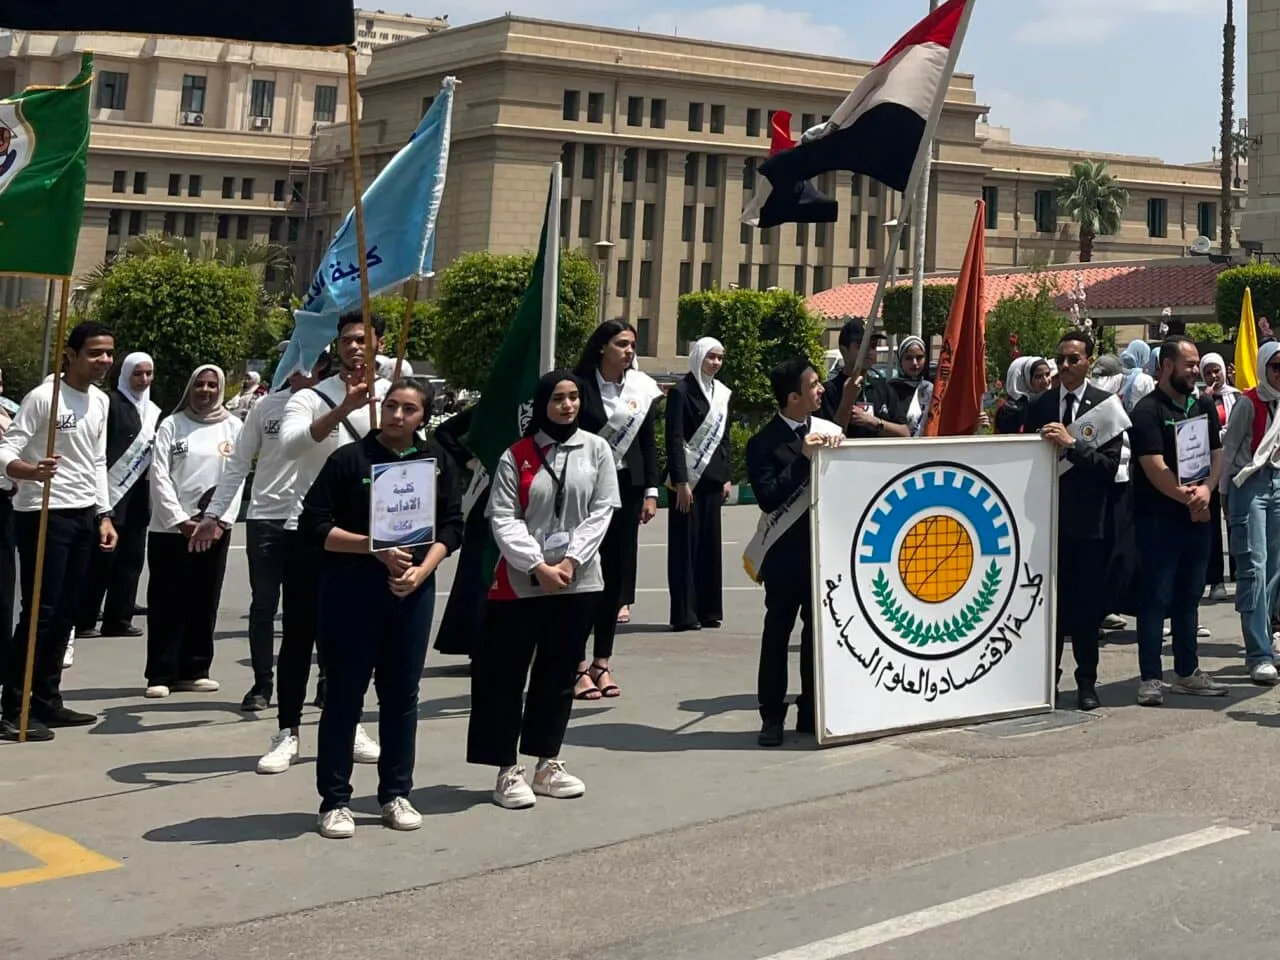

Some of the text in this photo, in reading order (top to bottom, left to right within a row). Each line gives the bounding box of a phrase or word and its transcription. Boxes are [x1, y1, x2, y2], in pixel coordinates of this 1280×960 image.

[823, 573, 883, 676] السياسية
[1008, 562, 1043, 631] كلية
[939, 620, 1022, 695] الاقتصاد
